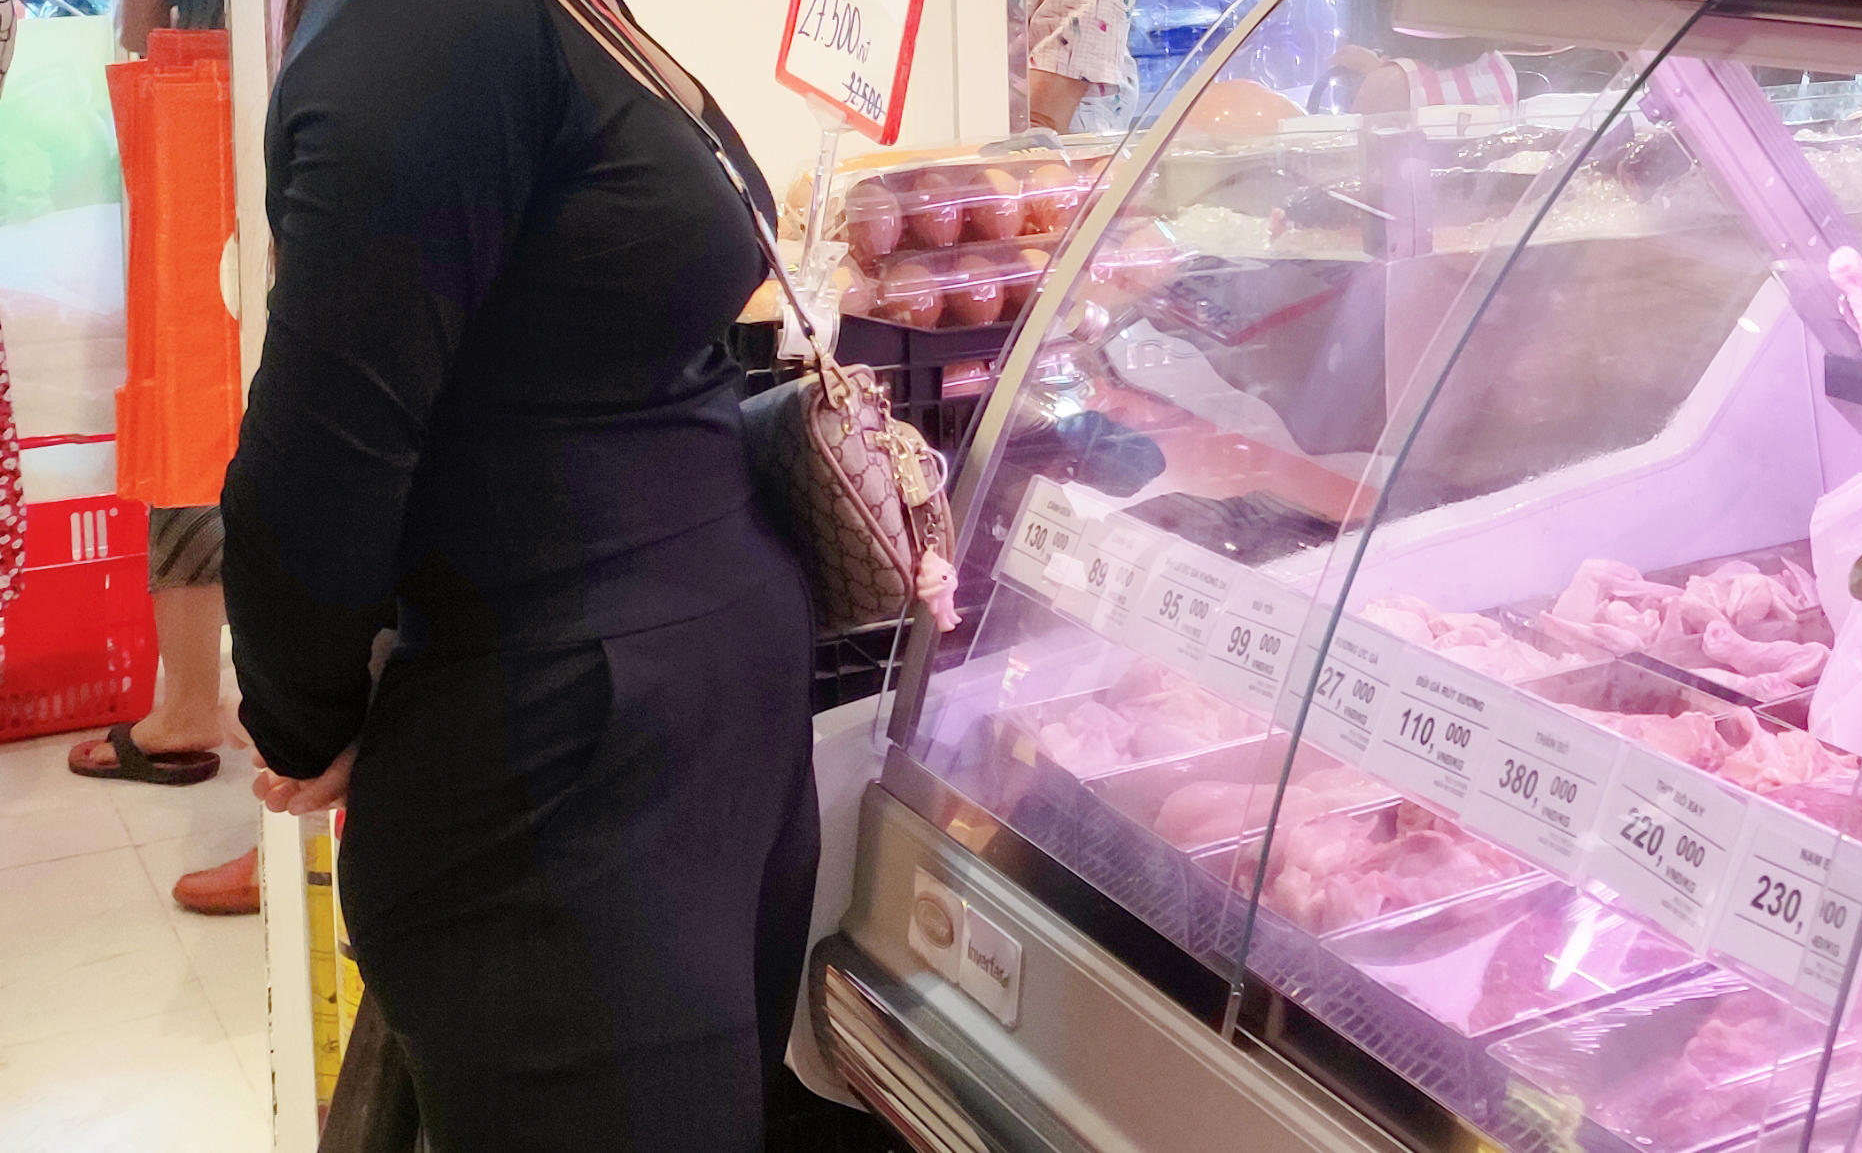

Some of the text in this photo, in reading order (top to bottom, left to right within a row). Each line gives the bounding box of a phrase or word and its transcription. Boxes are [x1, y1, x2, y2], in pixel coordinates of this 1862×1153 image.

[1352, 679, 1375, 704] 000
[1445, 722, 1471, 748] 000
[1550, 776, 1577, 803] 000
[1676, 835, 1705, 868] 000
